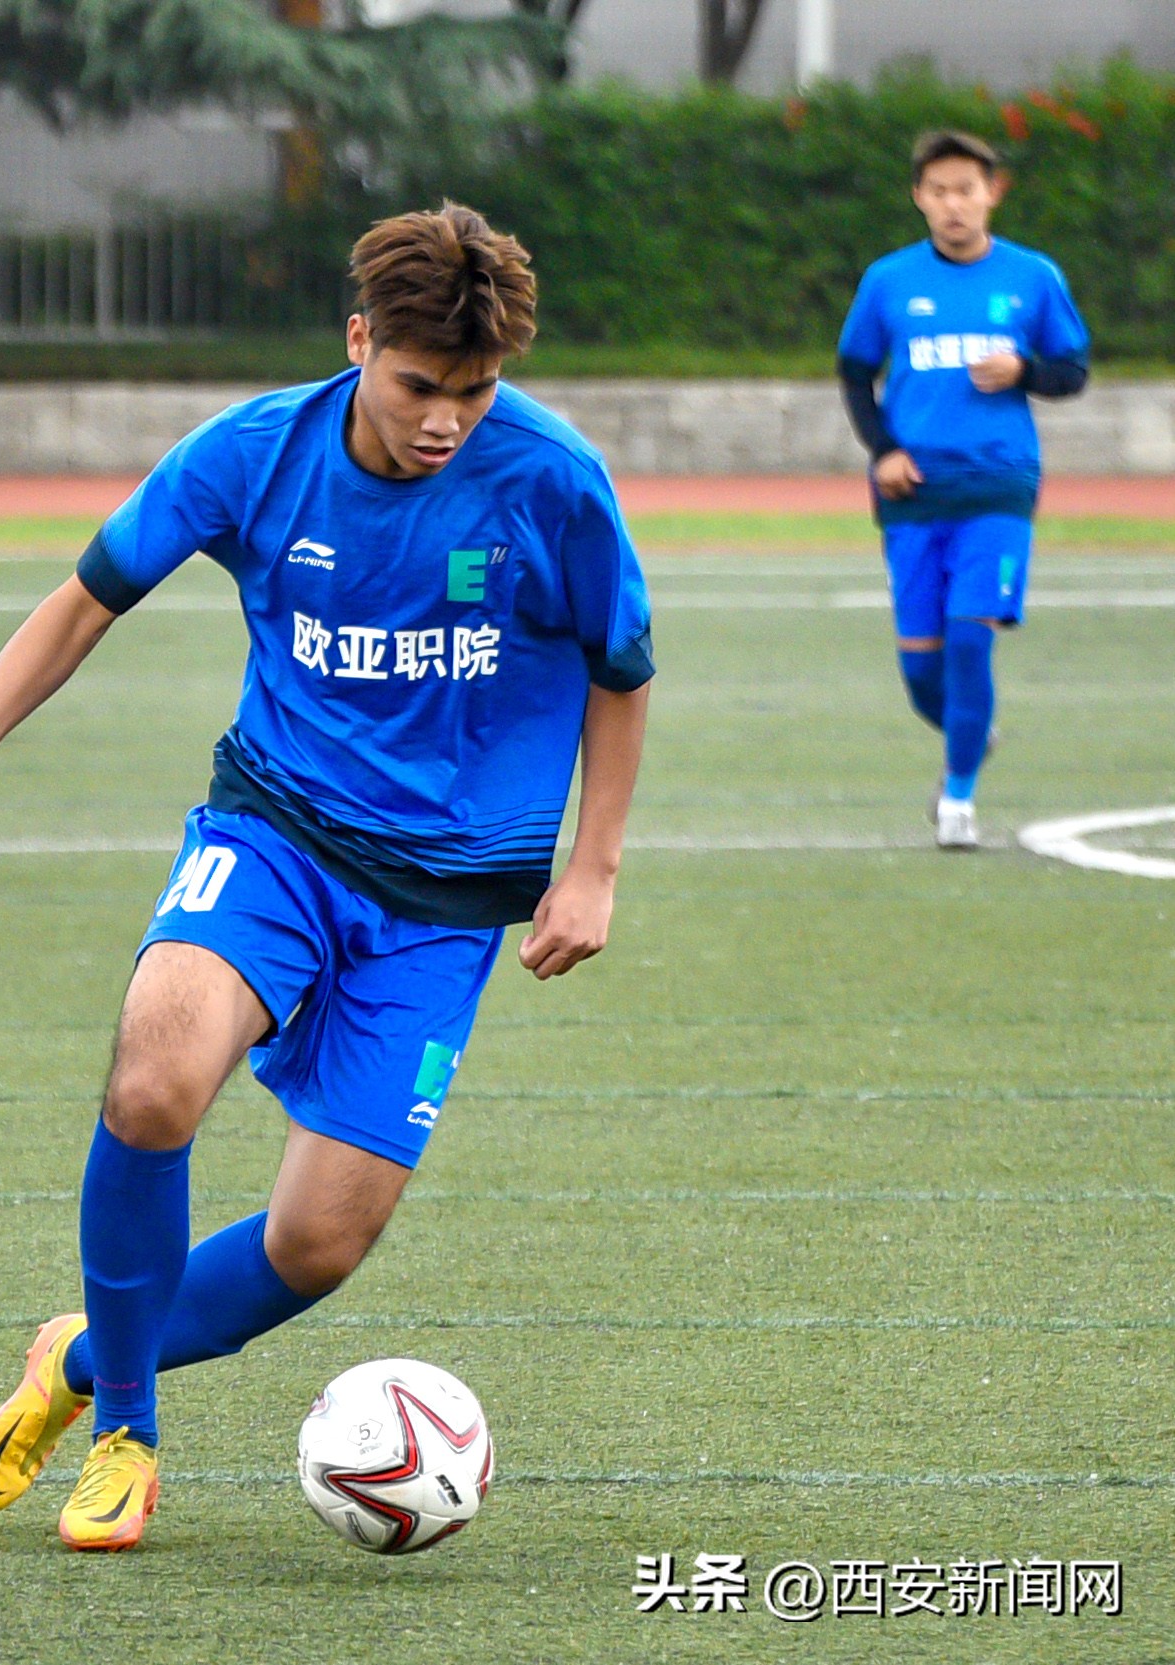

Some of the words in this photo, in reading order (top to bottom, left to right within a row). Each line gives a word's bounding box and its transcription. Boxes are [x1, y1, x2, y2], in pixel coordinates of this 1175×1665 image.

[288, 553, 335, 571] LI-NING
[293, 611, 501, 681] 欧亚职院
[156, 846, 238, 917] 20
[359, 1422, 371, 1441] 5
